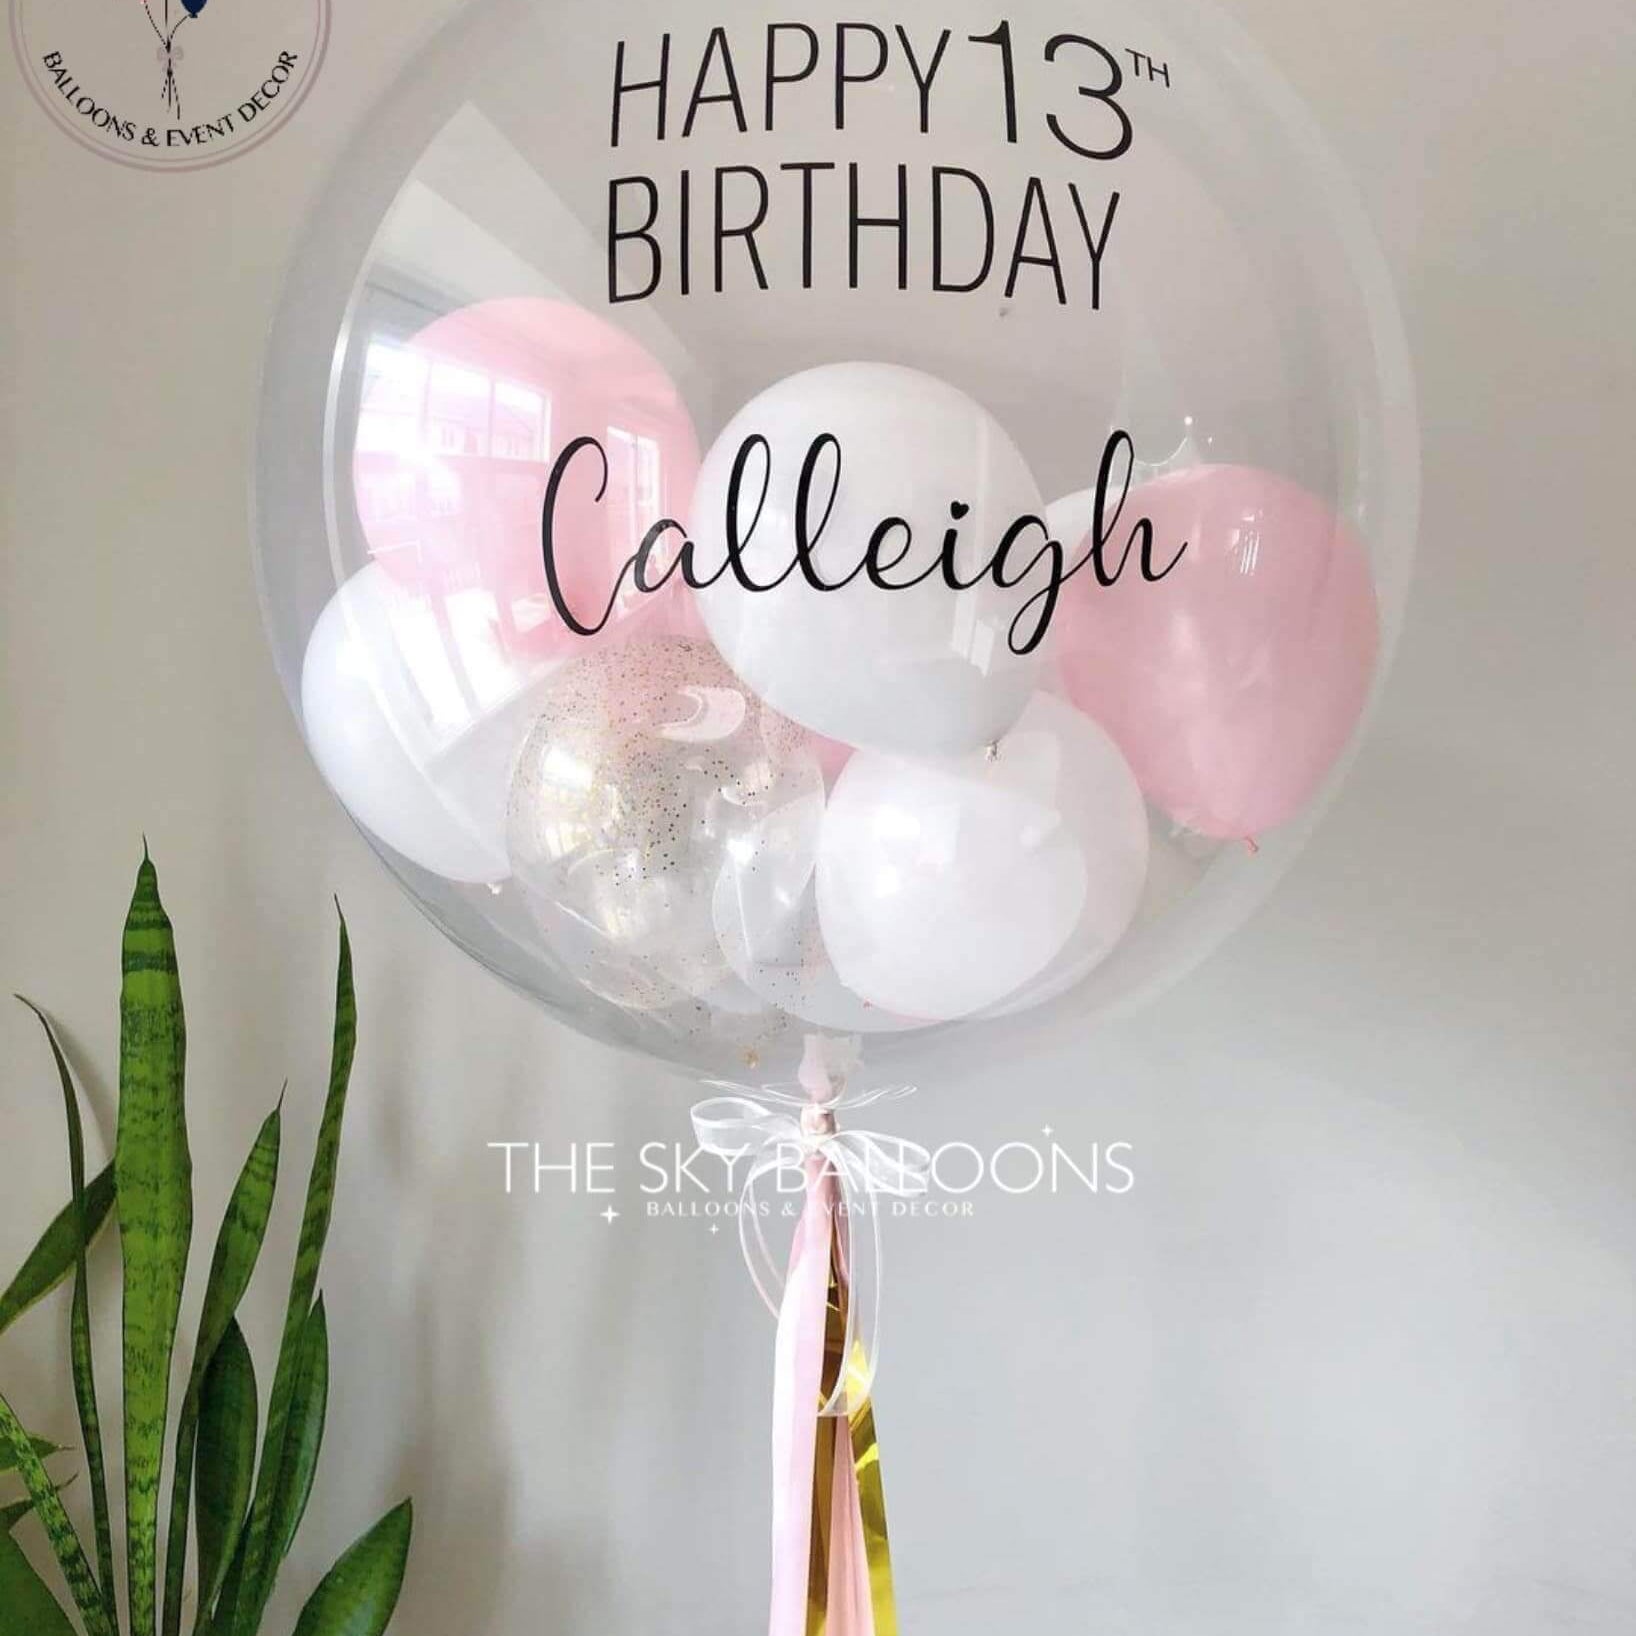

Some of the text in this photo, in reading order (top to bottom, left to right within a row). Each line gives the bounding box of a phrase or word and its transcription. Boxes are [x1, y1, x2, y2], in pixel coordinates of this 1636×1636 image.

[610, 22, 951, 147] HAPPY
[608, 161, 1121, 310] BIRTHDAY
[541, 429, 1188, 656] Calleigh
